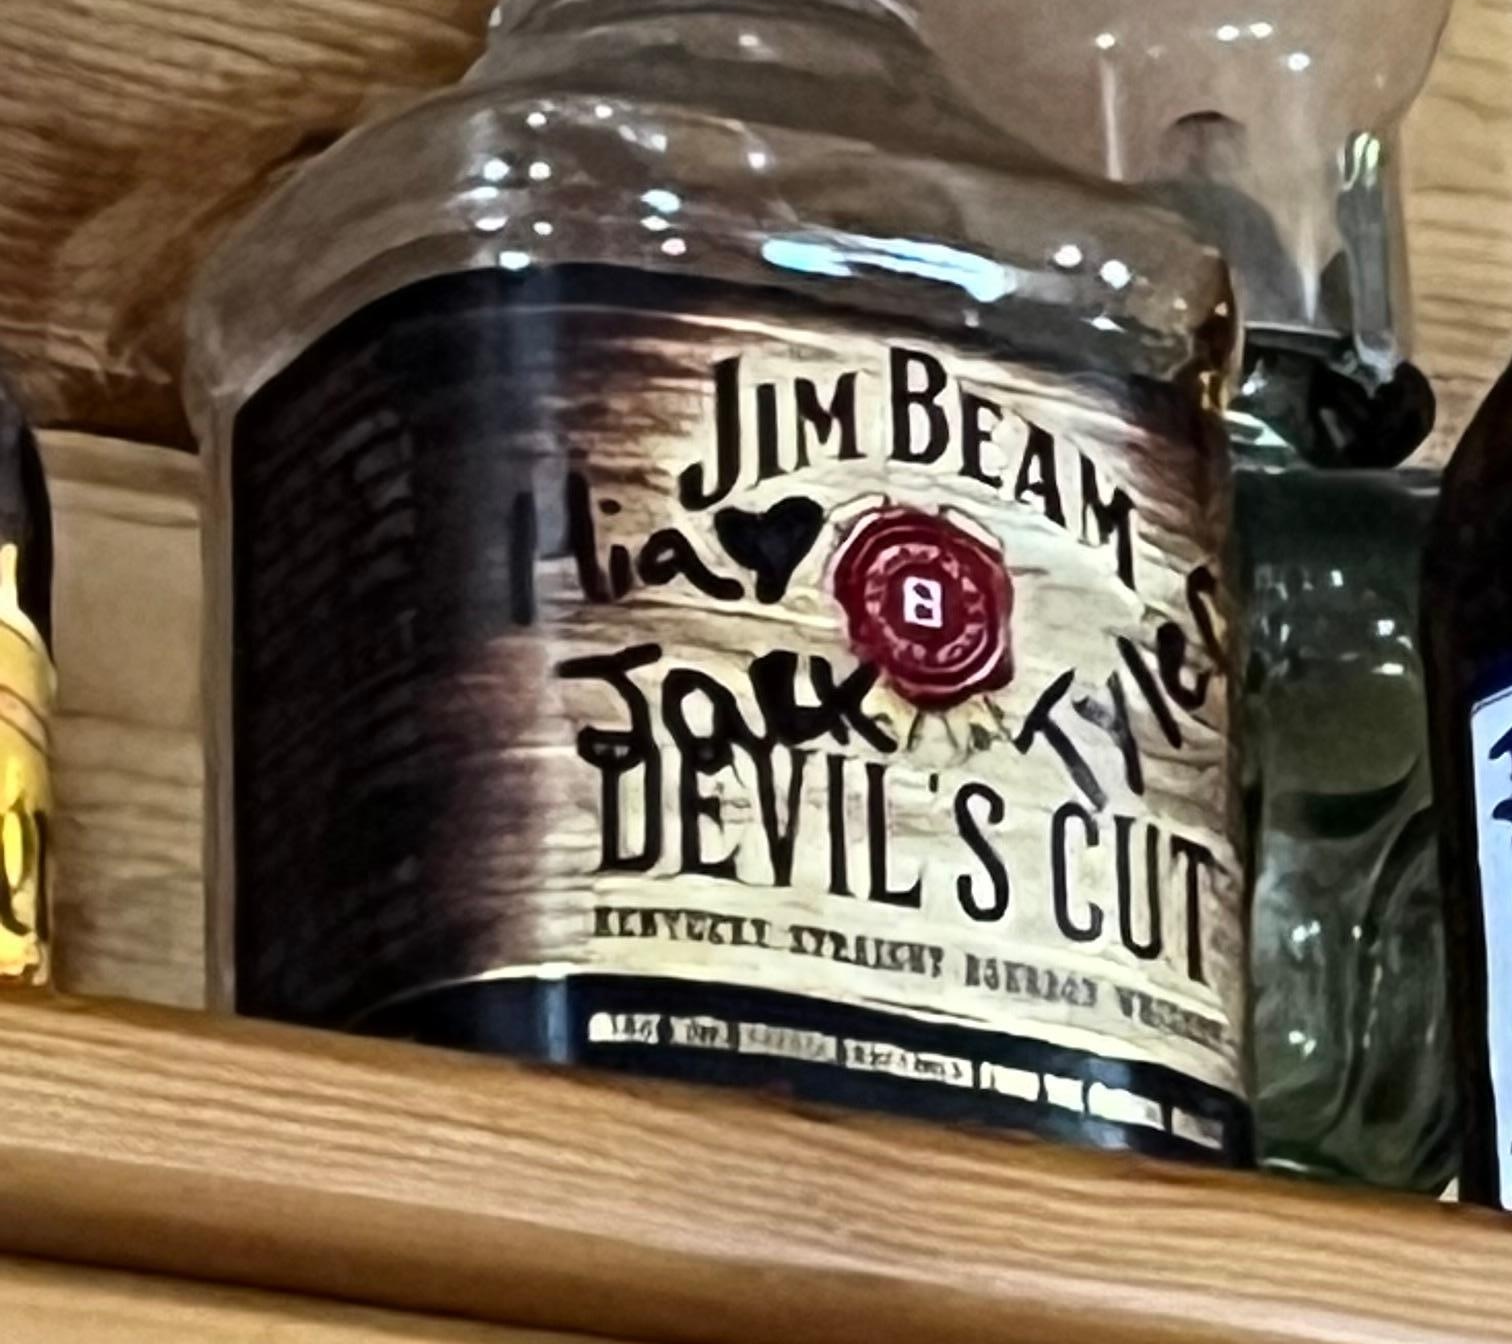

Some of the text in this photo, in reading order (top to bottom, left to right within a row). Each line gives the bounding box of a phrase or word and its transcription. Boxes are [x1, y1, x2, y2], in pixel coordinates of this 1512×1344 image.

[680, 346, 1137, 594] JIM BEAM
[599, 746, 1222, 987] DEVIL'S CUT
